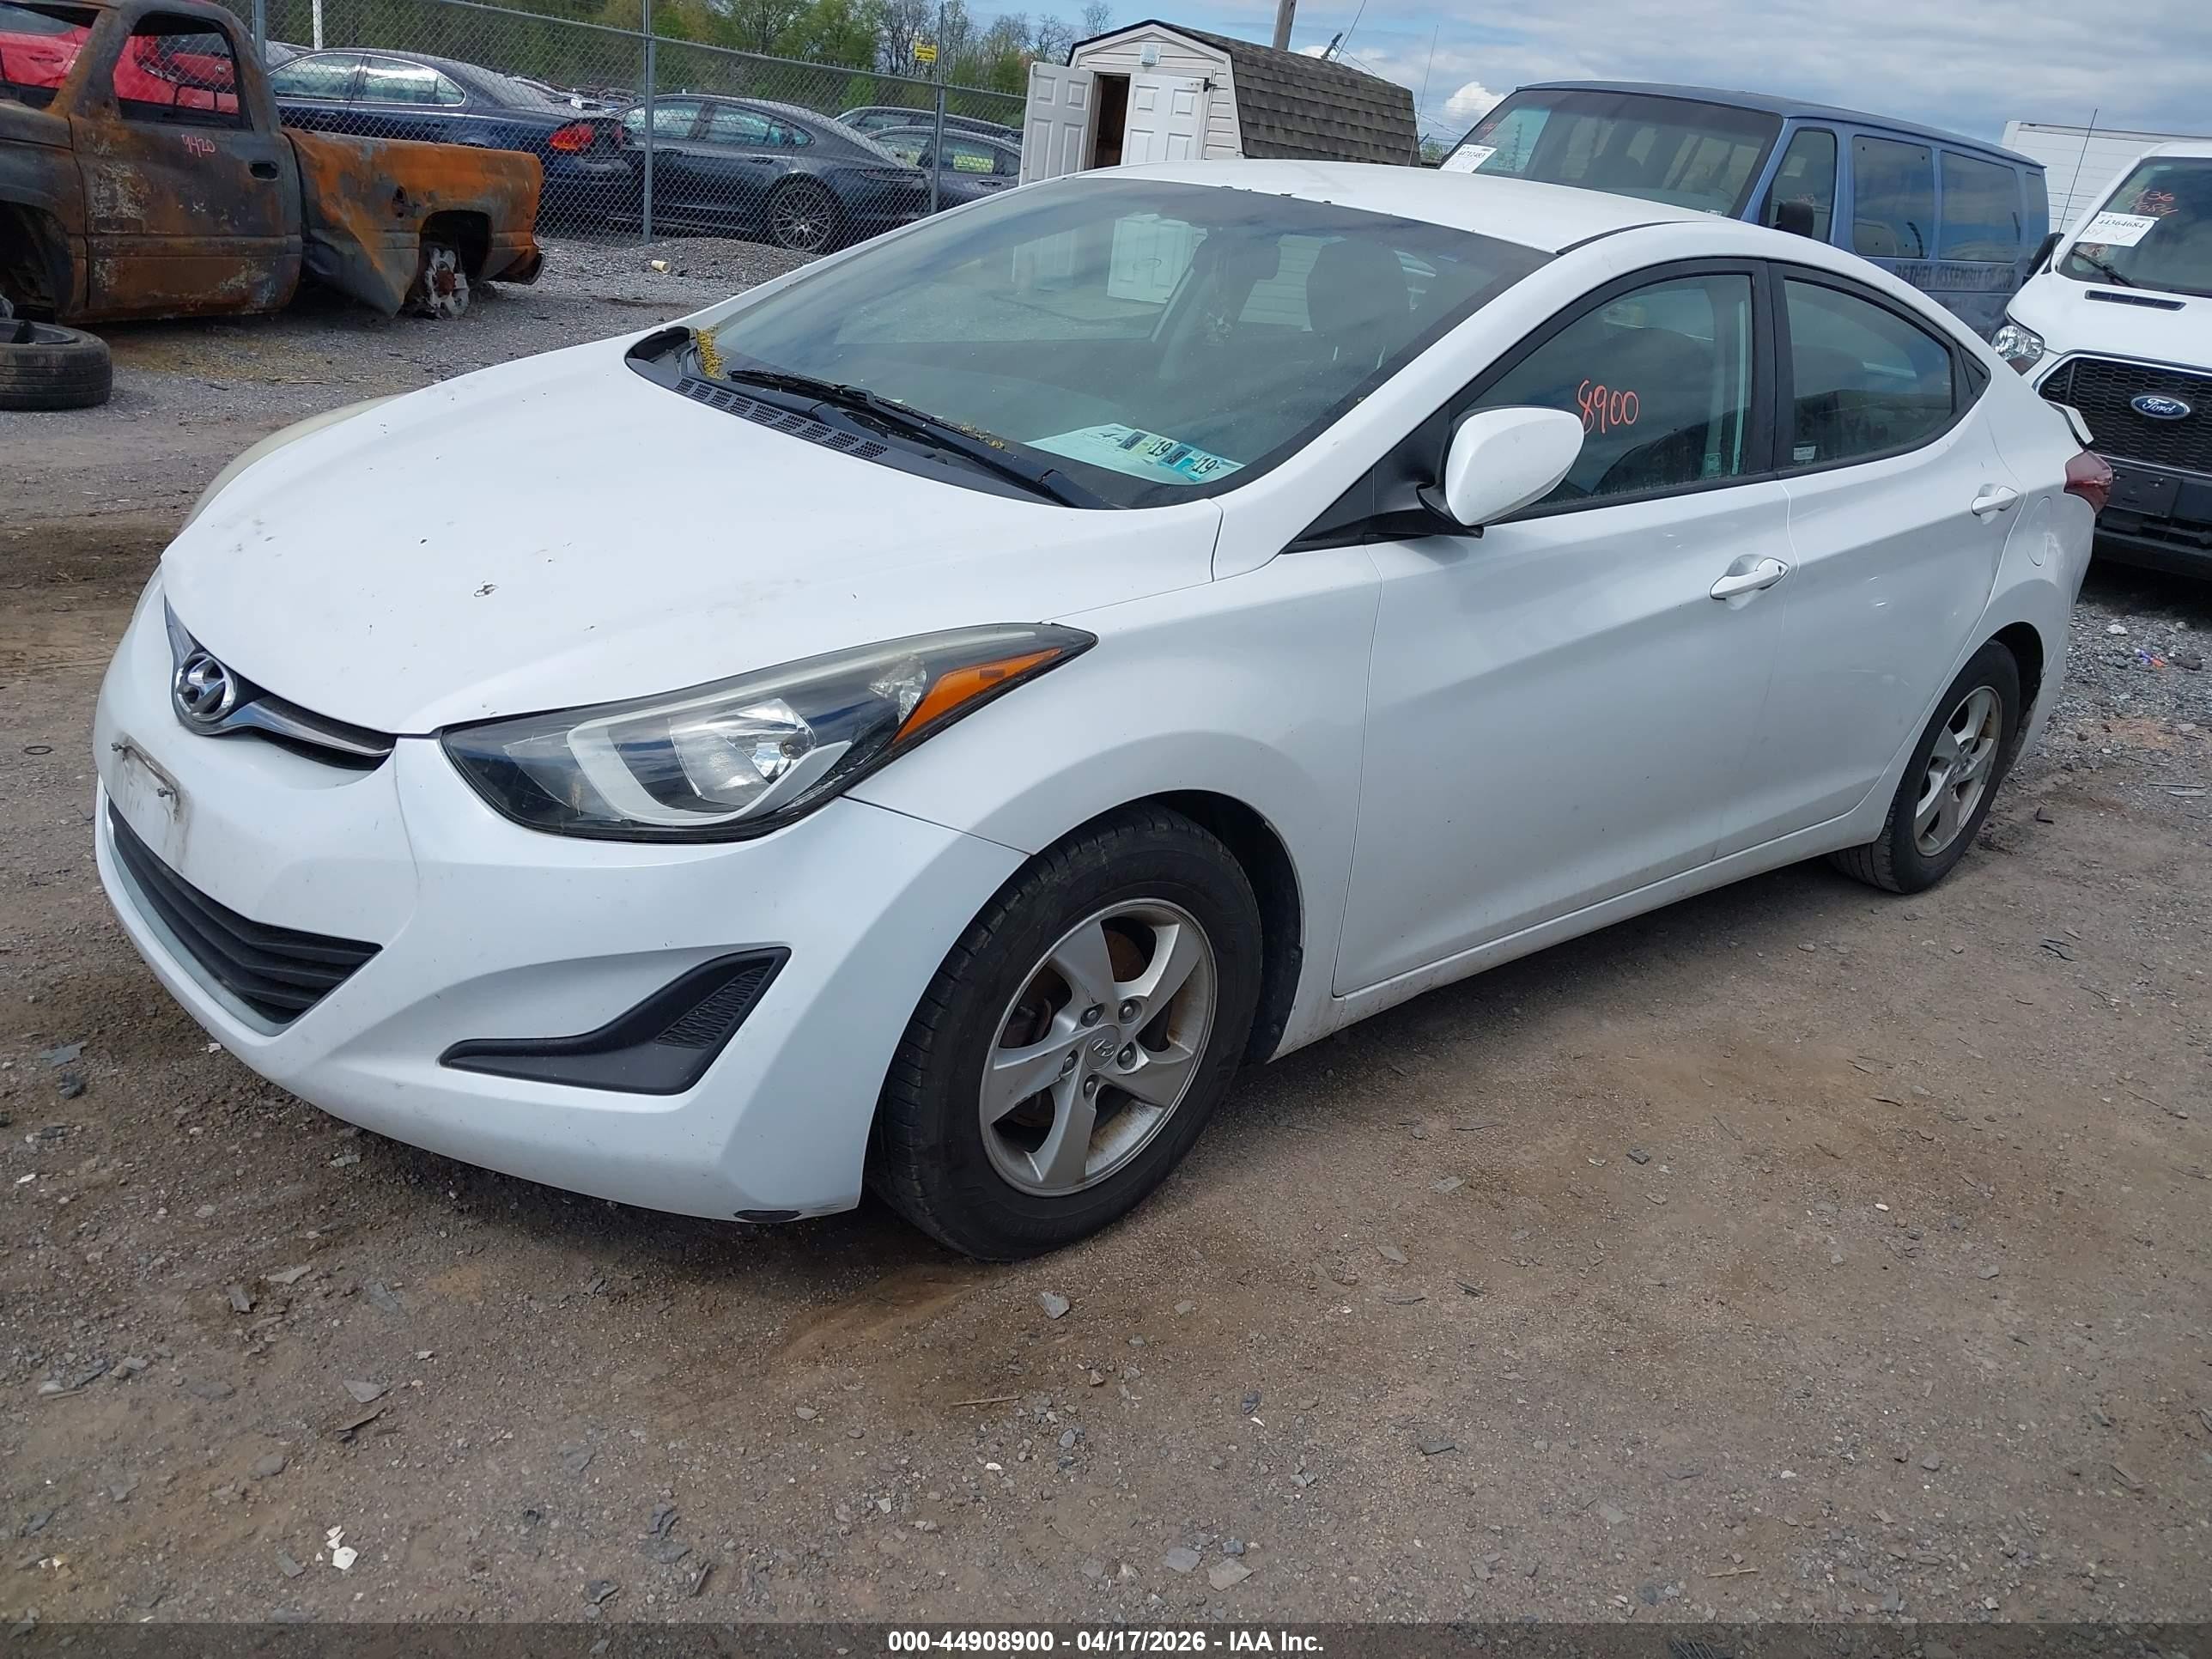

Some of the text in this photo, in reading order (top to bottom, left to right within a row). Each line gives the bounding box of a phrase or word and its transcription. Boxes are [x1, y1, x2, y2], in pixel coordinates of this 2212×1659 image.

[1577, 379, 1638, 434] 8900
[2142, 398, 2177, 414] Ford
[1147, 440, 1174, 457] 19
[1191, 458, 1218, 475] 19
